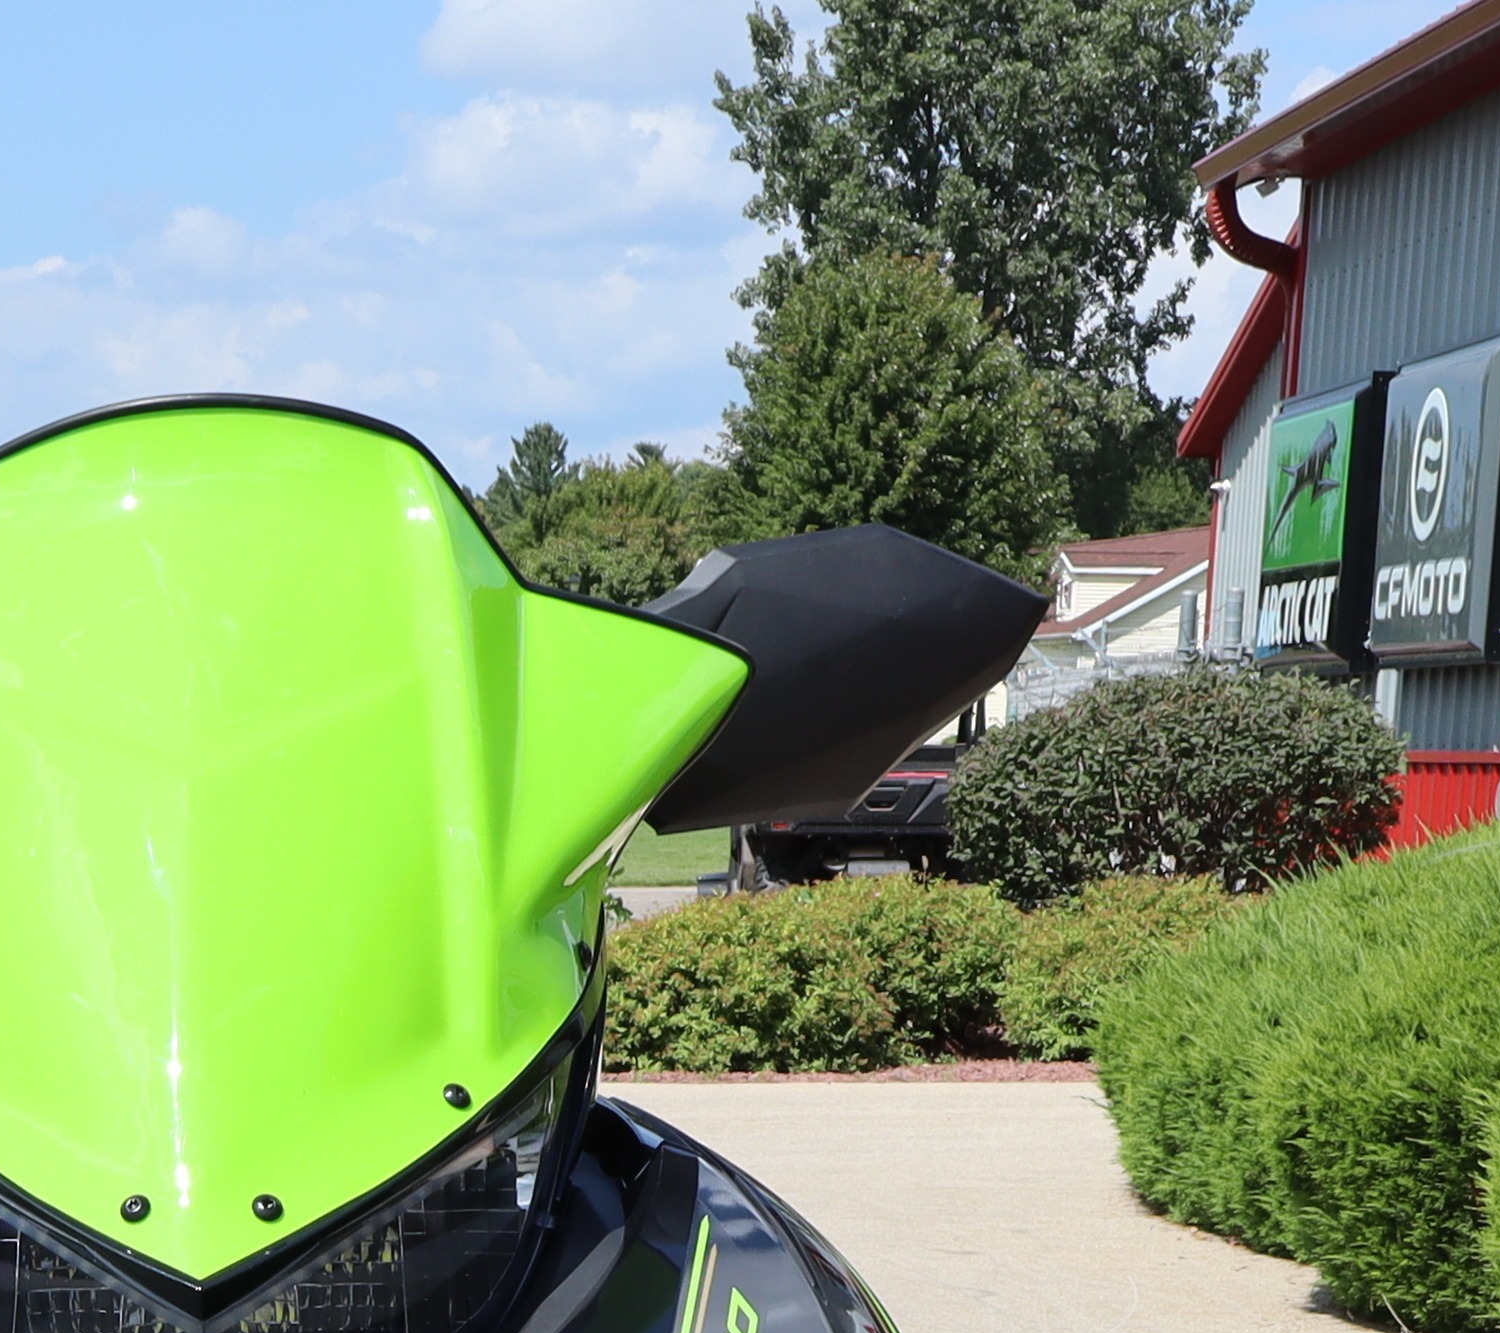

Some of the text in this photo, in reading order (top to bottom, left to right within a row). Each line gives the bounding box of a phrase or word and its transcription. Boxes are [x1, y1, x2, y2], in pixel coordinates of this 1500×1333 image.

[1257, 575, 1338, 647] ARCTIC CAT
[1374, 556, 1467, 621] CFMOTO
